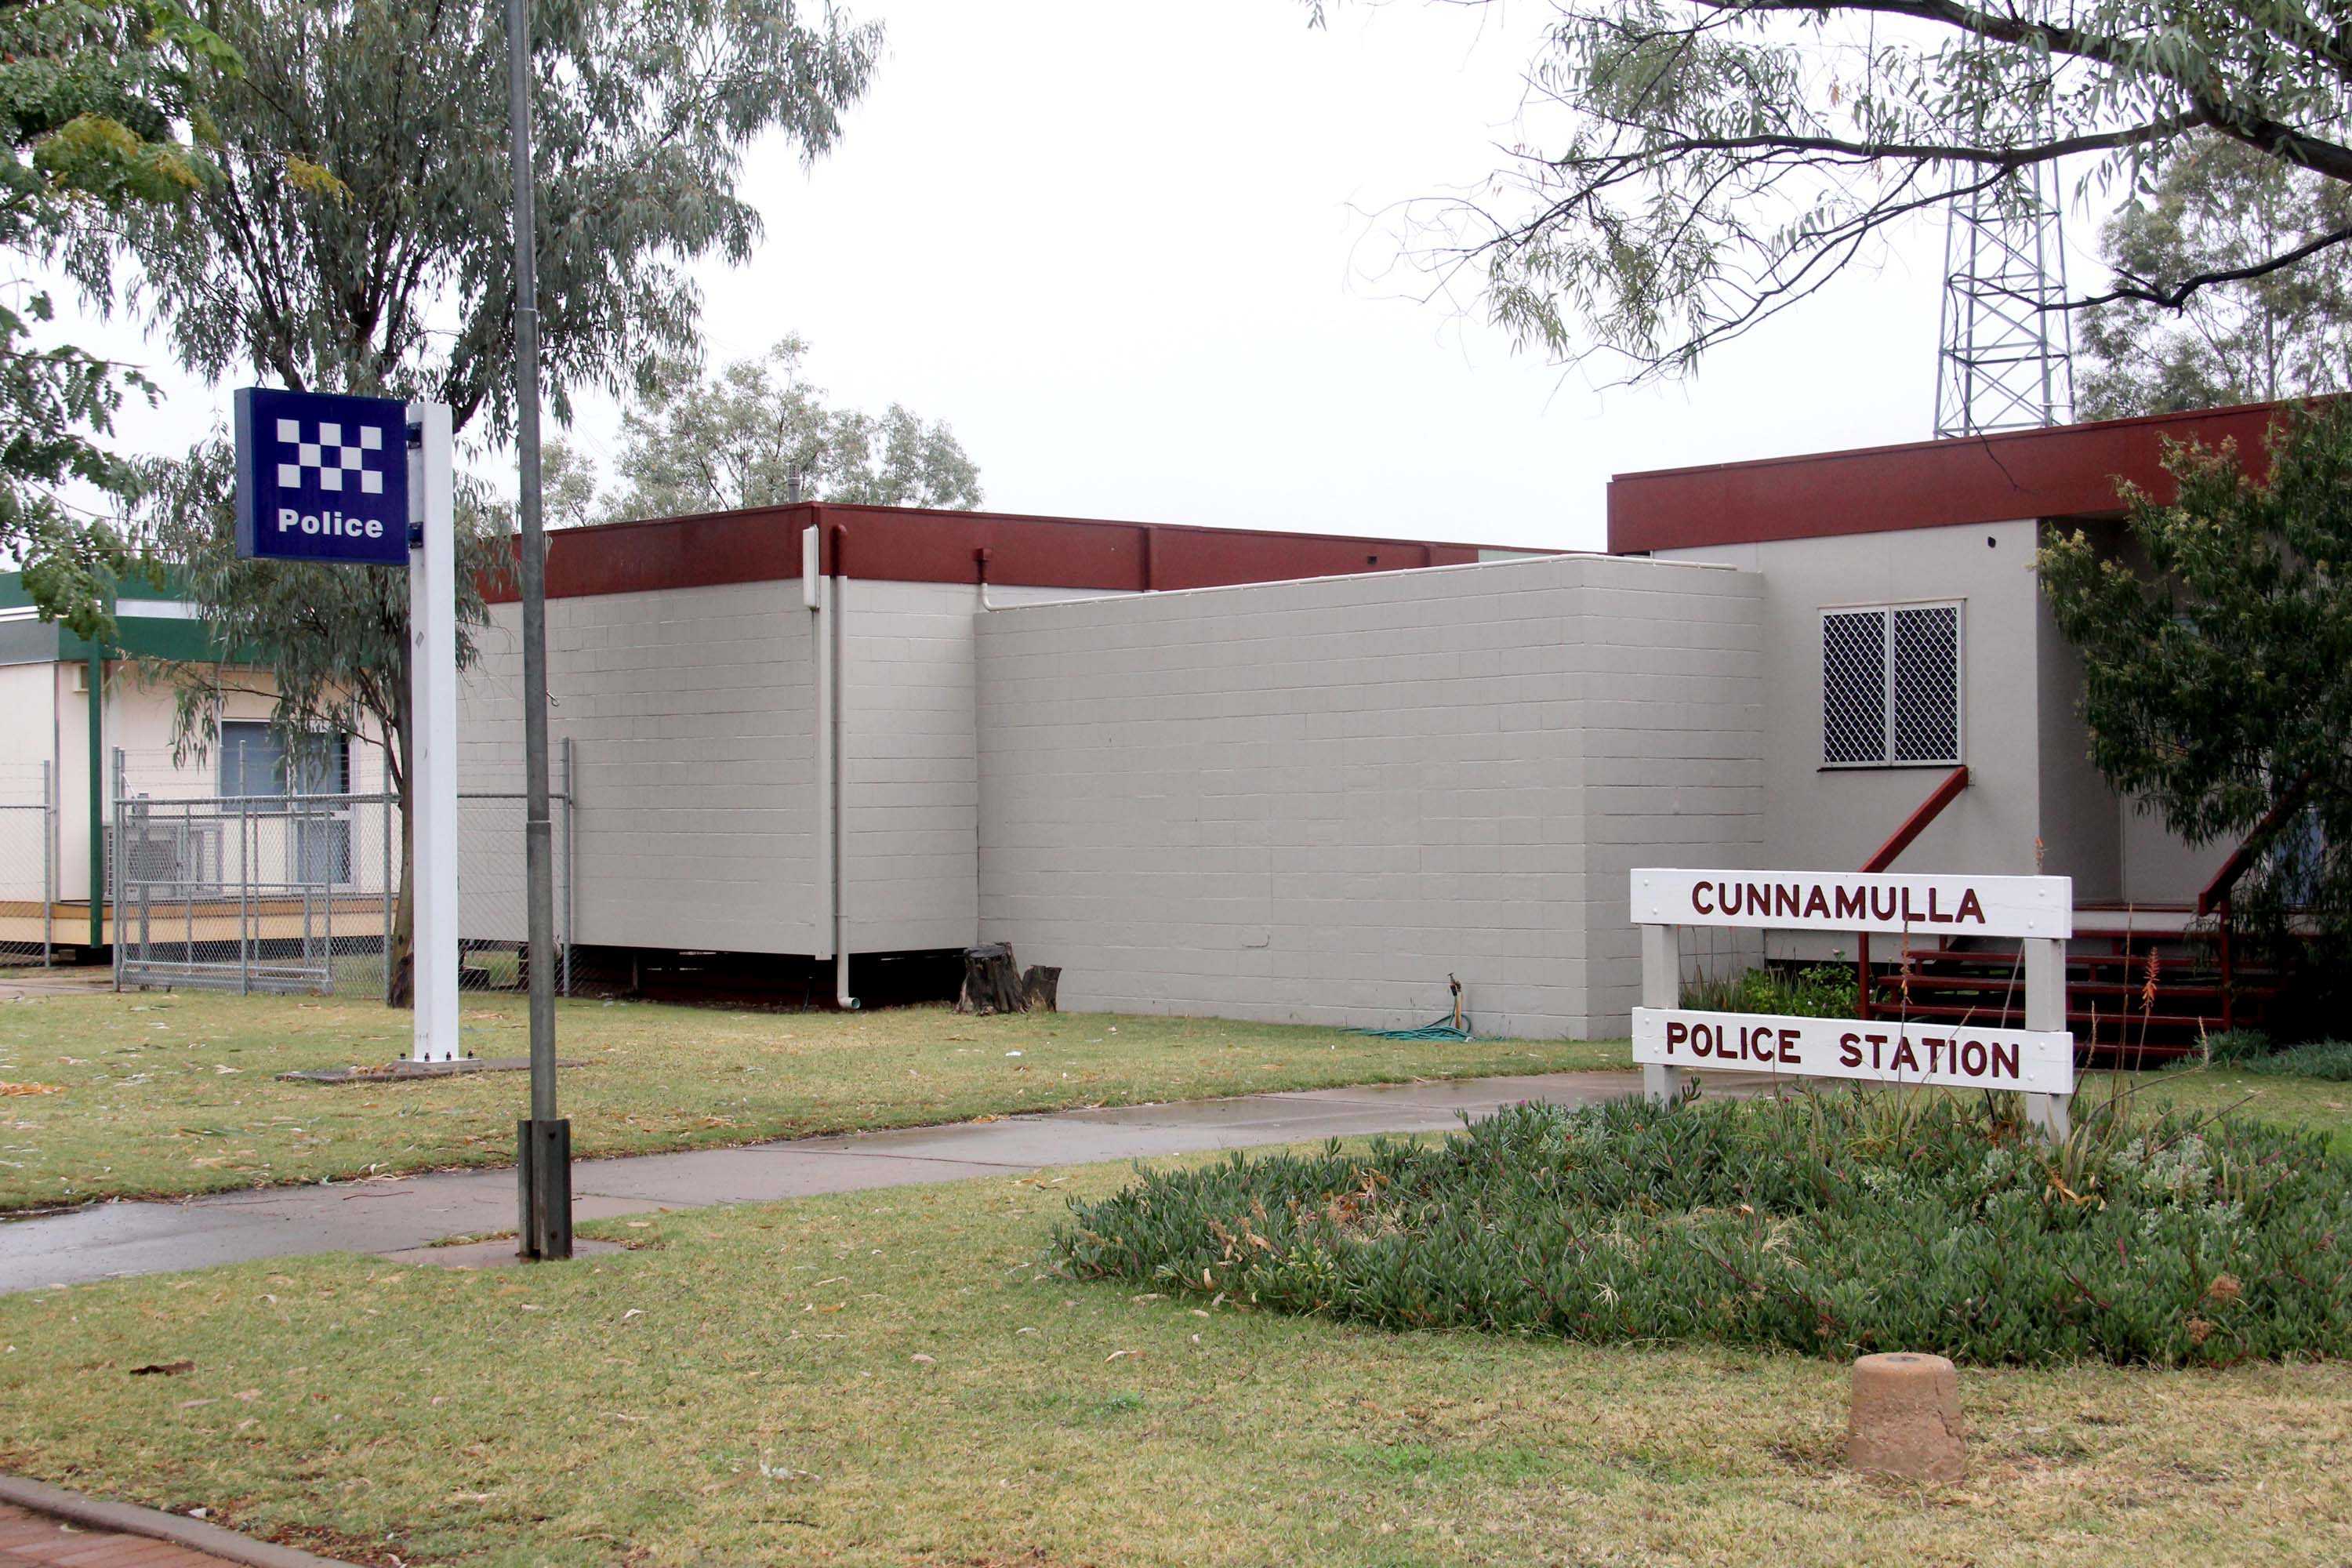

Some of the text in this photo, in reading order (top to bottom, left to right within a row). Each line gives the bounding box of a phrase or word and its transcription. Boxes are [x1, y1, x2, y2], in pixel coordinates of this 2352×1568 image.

[278, 508, 383, 538] Police
[1692, 881, 1986, 924] CUNNAMULLA
[1666, 1022, 2020, 1079] POLICE STATION
